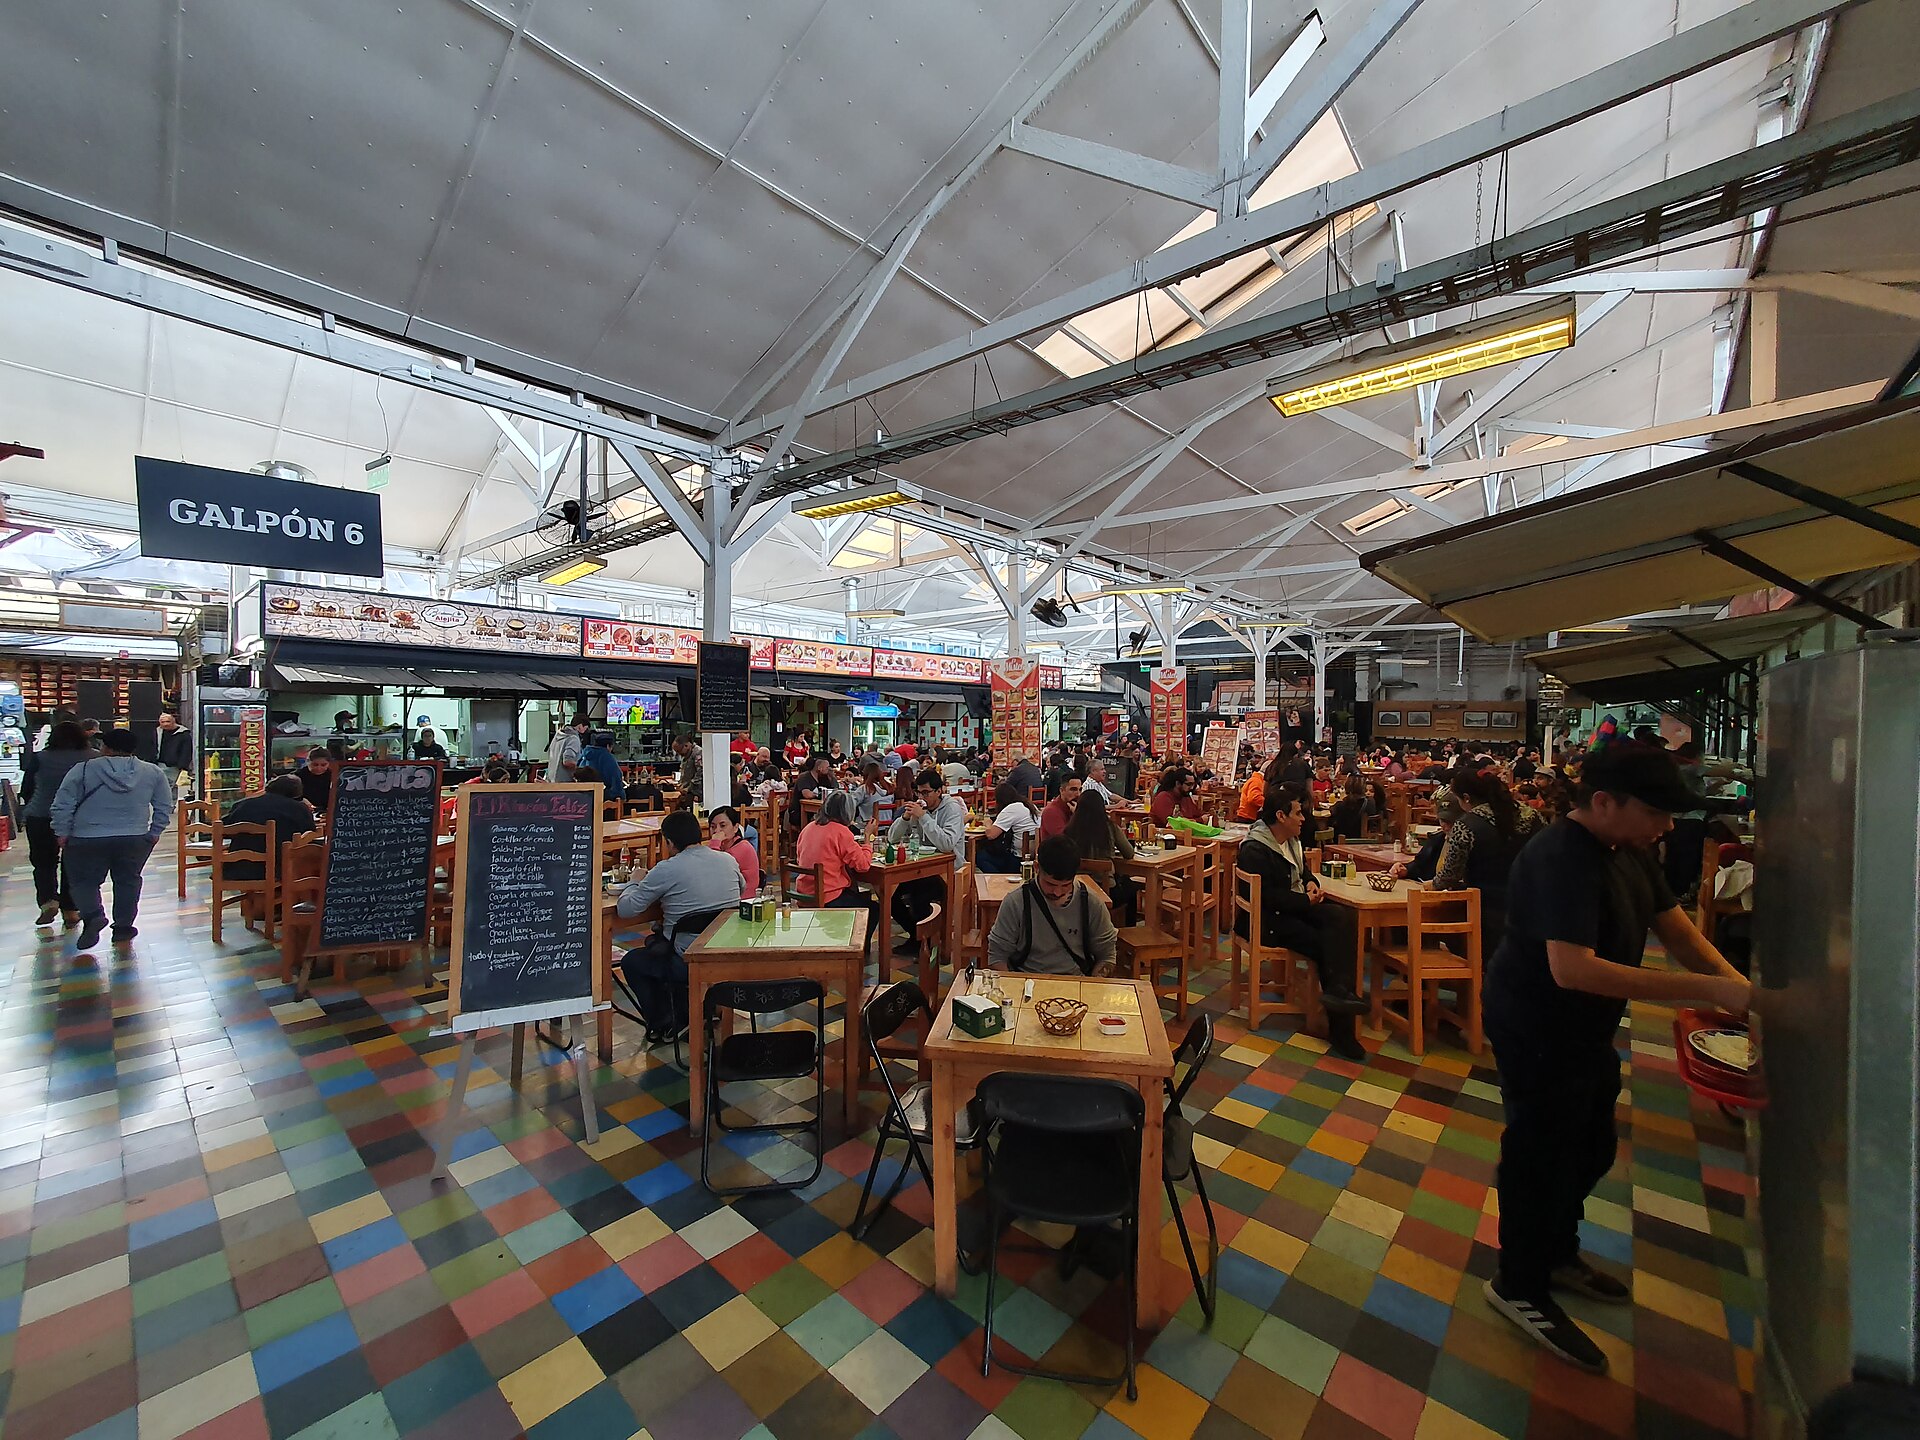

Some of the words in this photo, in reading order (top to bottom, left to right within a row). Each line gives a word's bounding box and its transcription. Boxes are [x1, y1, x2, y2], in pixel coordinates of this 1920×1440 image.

[169, 499, 335, 542] GALPÓN
[344, 523, 364, 545] 6
[245, 722, 260, 791] DESAYUNOS
[345, 766, 432, 793] Alejita
[491, 835, 521, 844] Costillar
[542, 853, 562, 861] Salsa
[490, 863, 522, 873] Pescado
[468, 950, 487, 962] todo
